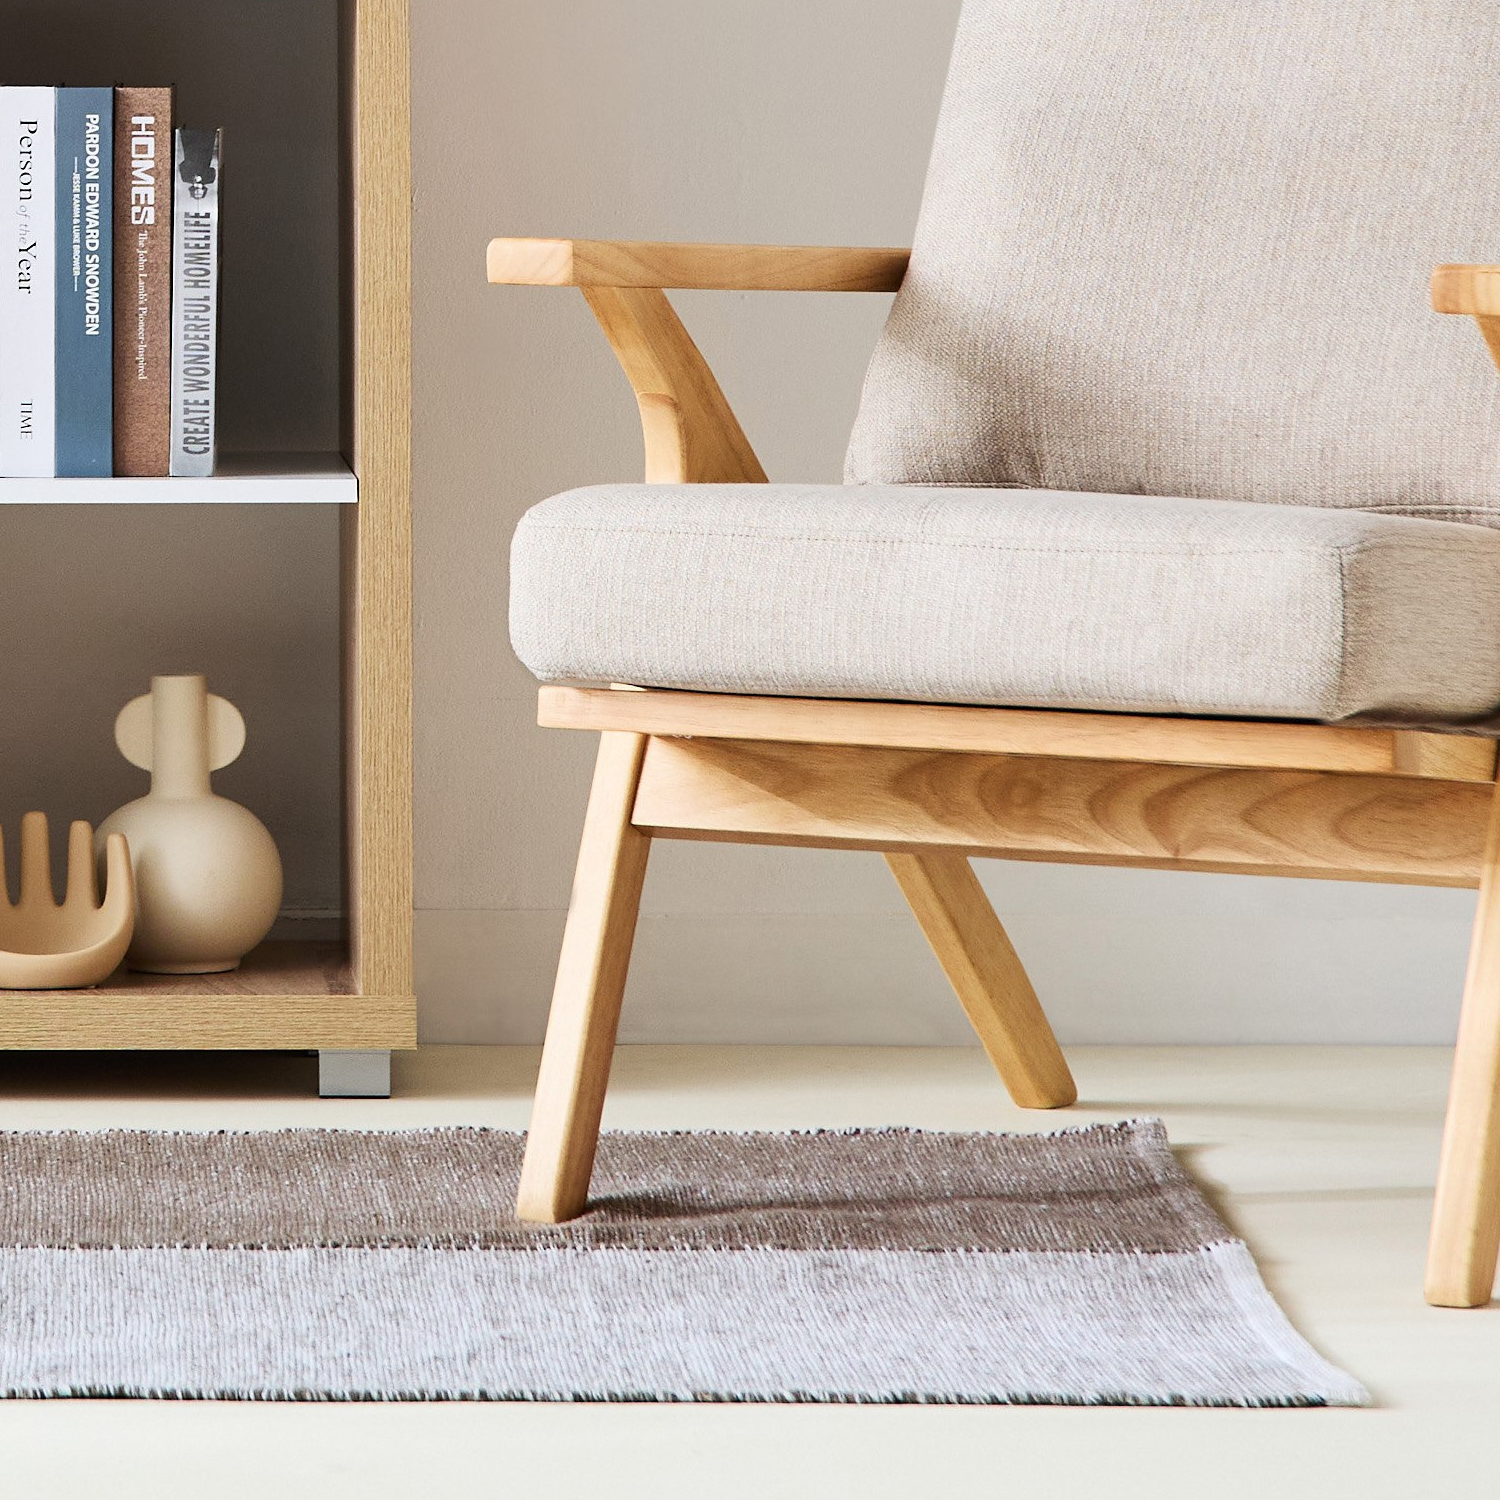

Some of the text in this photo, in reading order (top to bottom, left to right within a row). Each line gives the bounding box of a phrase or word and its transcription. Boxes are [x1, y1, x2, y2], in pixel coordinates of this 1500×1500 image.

[15, 118, 39, 295] Person of the Year
[85, 113, 100, 336] PARDON EDWARD SNOWDEN
[131, 115, 155, 226] HOMES
[136, 249, 148, 271] John
[182, 211, 211, 455] CREATE WONDERFUL HOMELIFE
[20, 399, 34, 440] TIME
